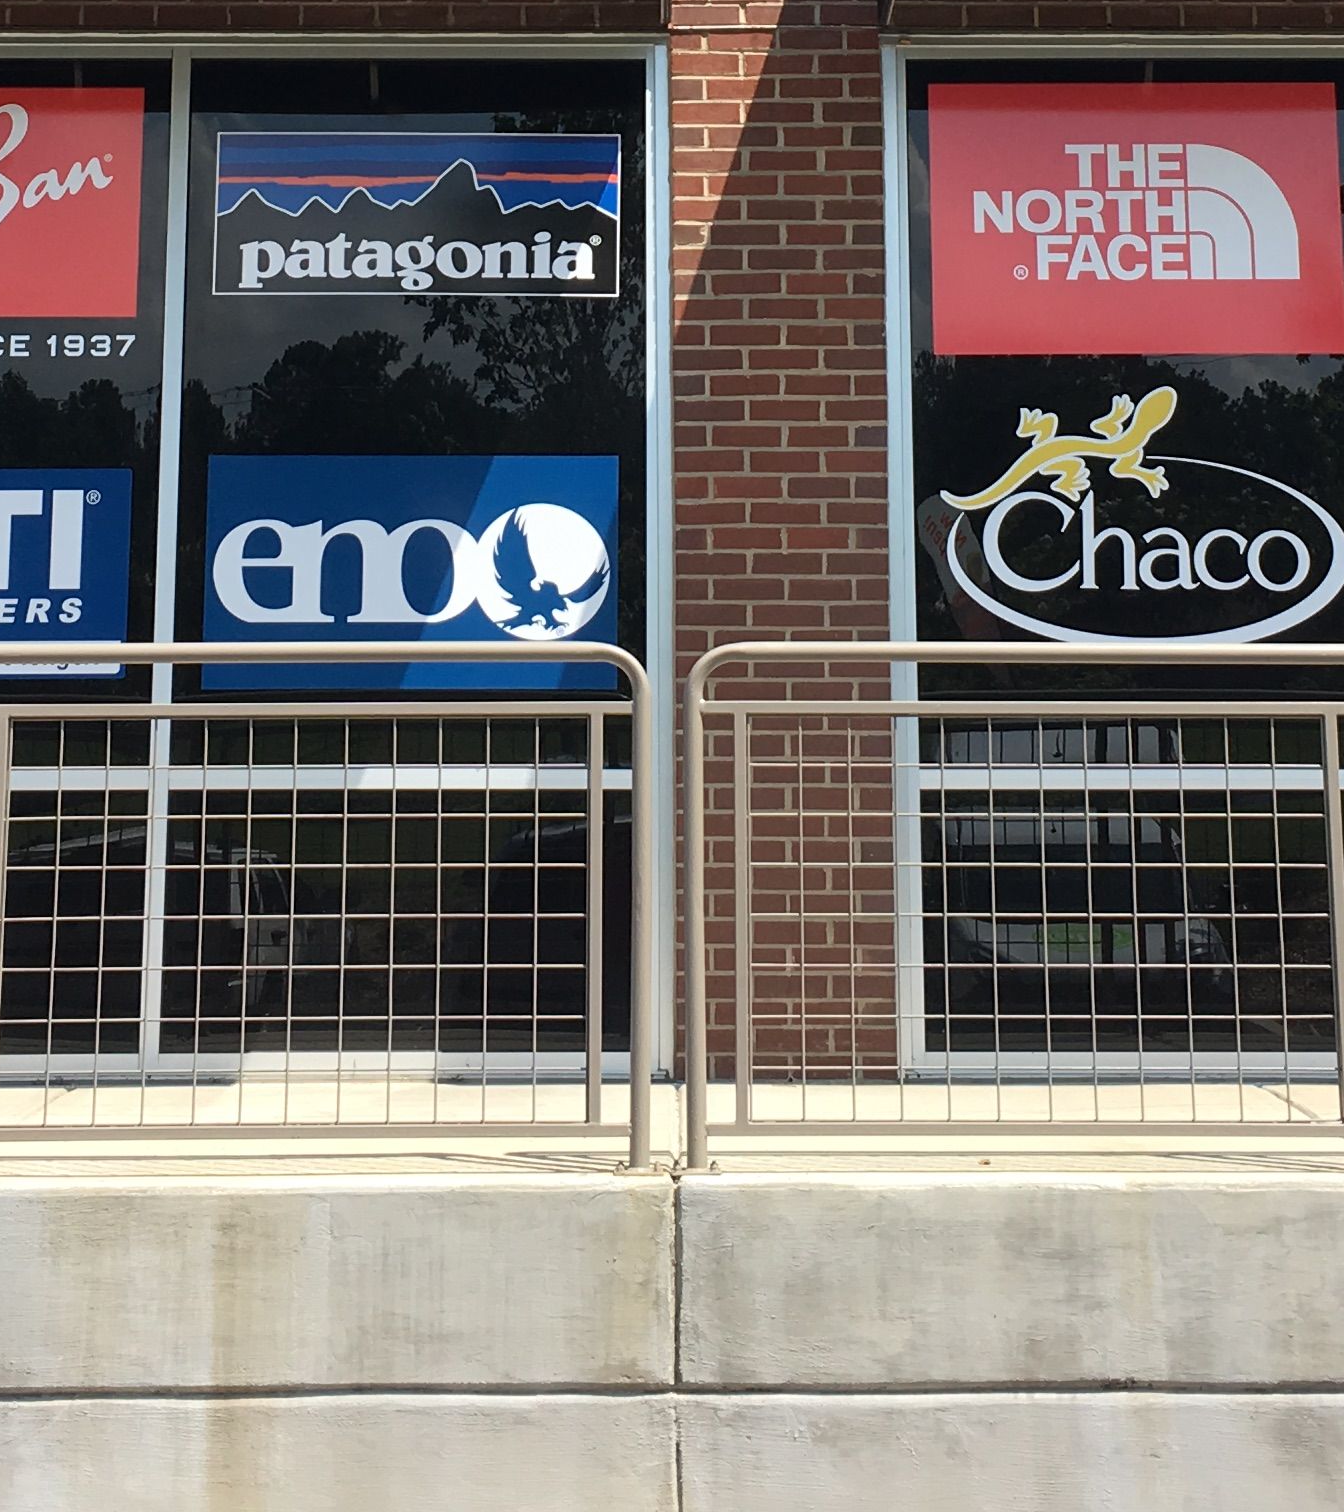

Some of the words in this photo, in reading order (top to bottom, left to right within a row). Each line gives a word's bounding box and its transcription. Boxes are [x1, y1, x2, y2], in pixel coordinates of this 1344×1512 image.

[1064, 143, 1184, 188] THE
[972, 189, 1187, 233] NORTH
[238, 230, 596, 291] patagonia
[1035, 234, 1189, 281] FACE
[46, 334, 137, 357] 1937
[982, 489, 1311, 592] Chaco
